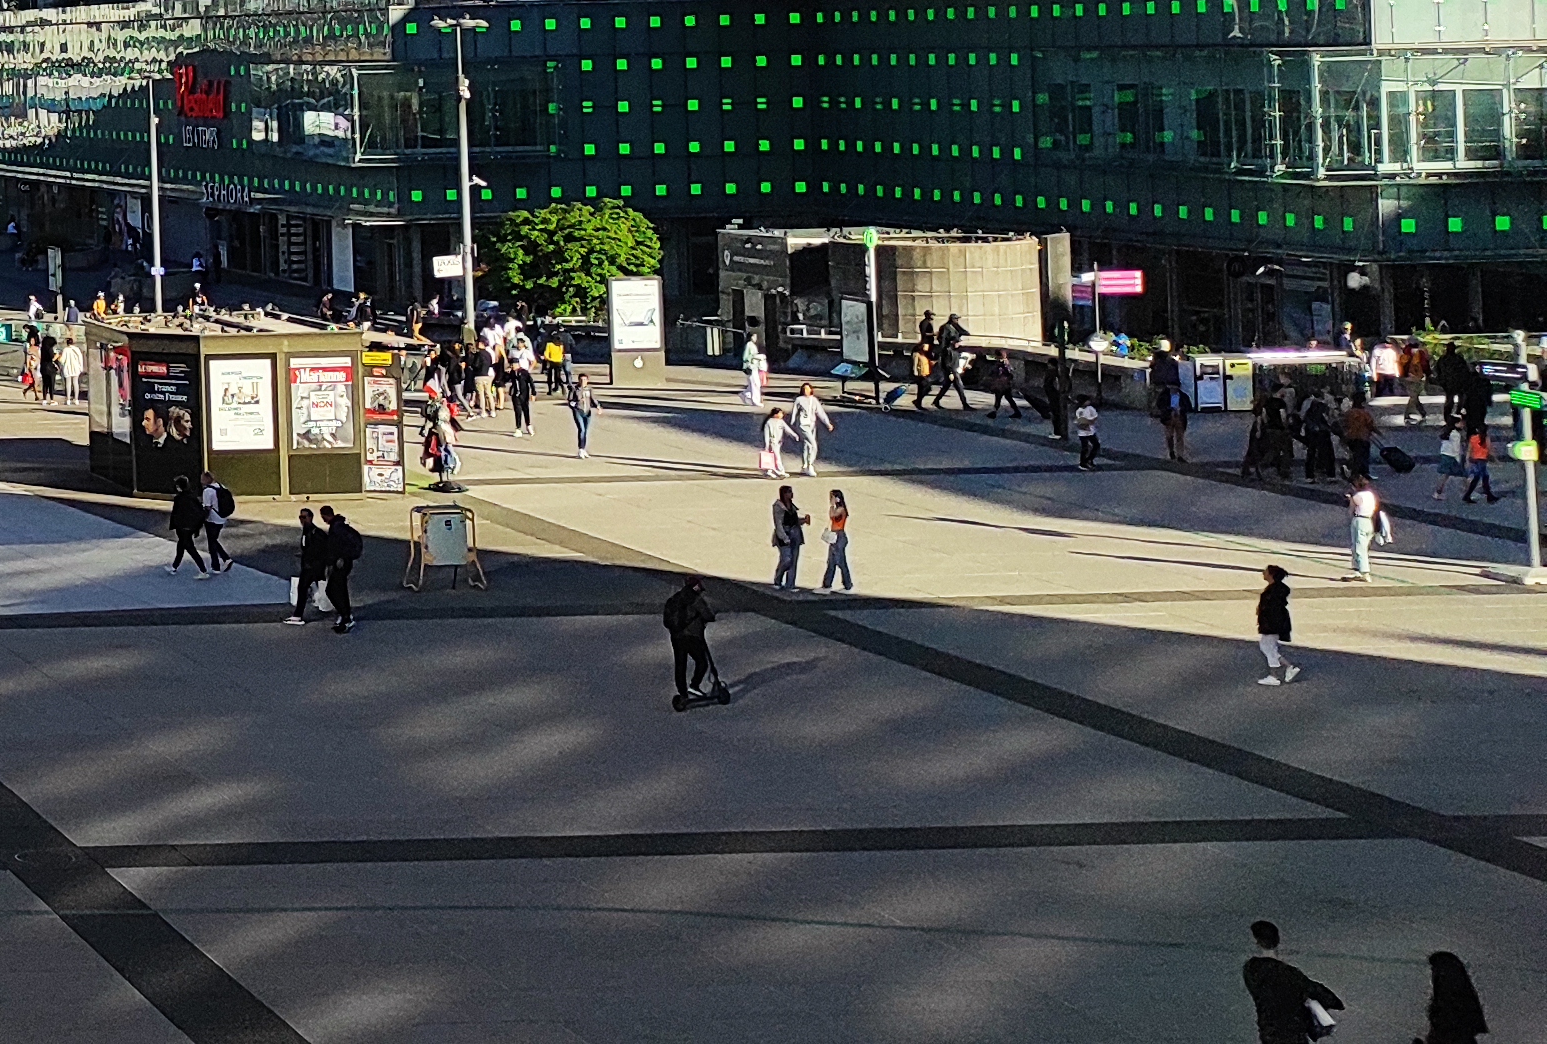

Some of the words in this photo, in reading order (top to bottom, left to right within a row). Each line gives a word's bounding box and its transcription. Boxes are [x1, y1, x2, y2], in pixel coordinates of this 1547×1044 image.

[202, 181, 250, 205] SEPHORA
[295, 367, 347, 383] Marianne
[312, 401, 333, 409] NON
